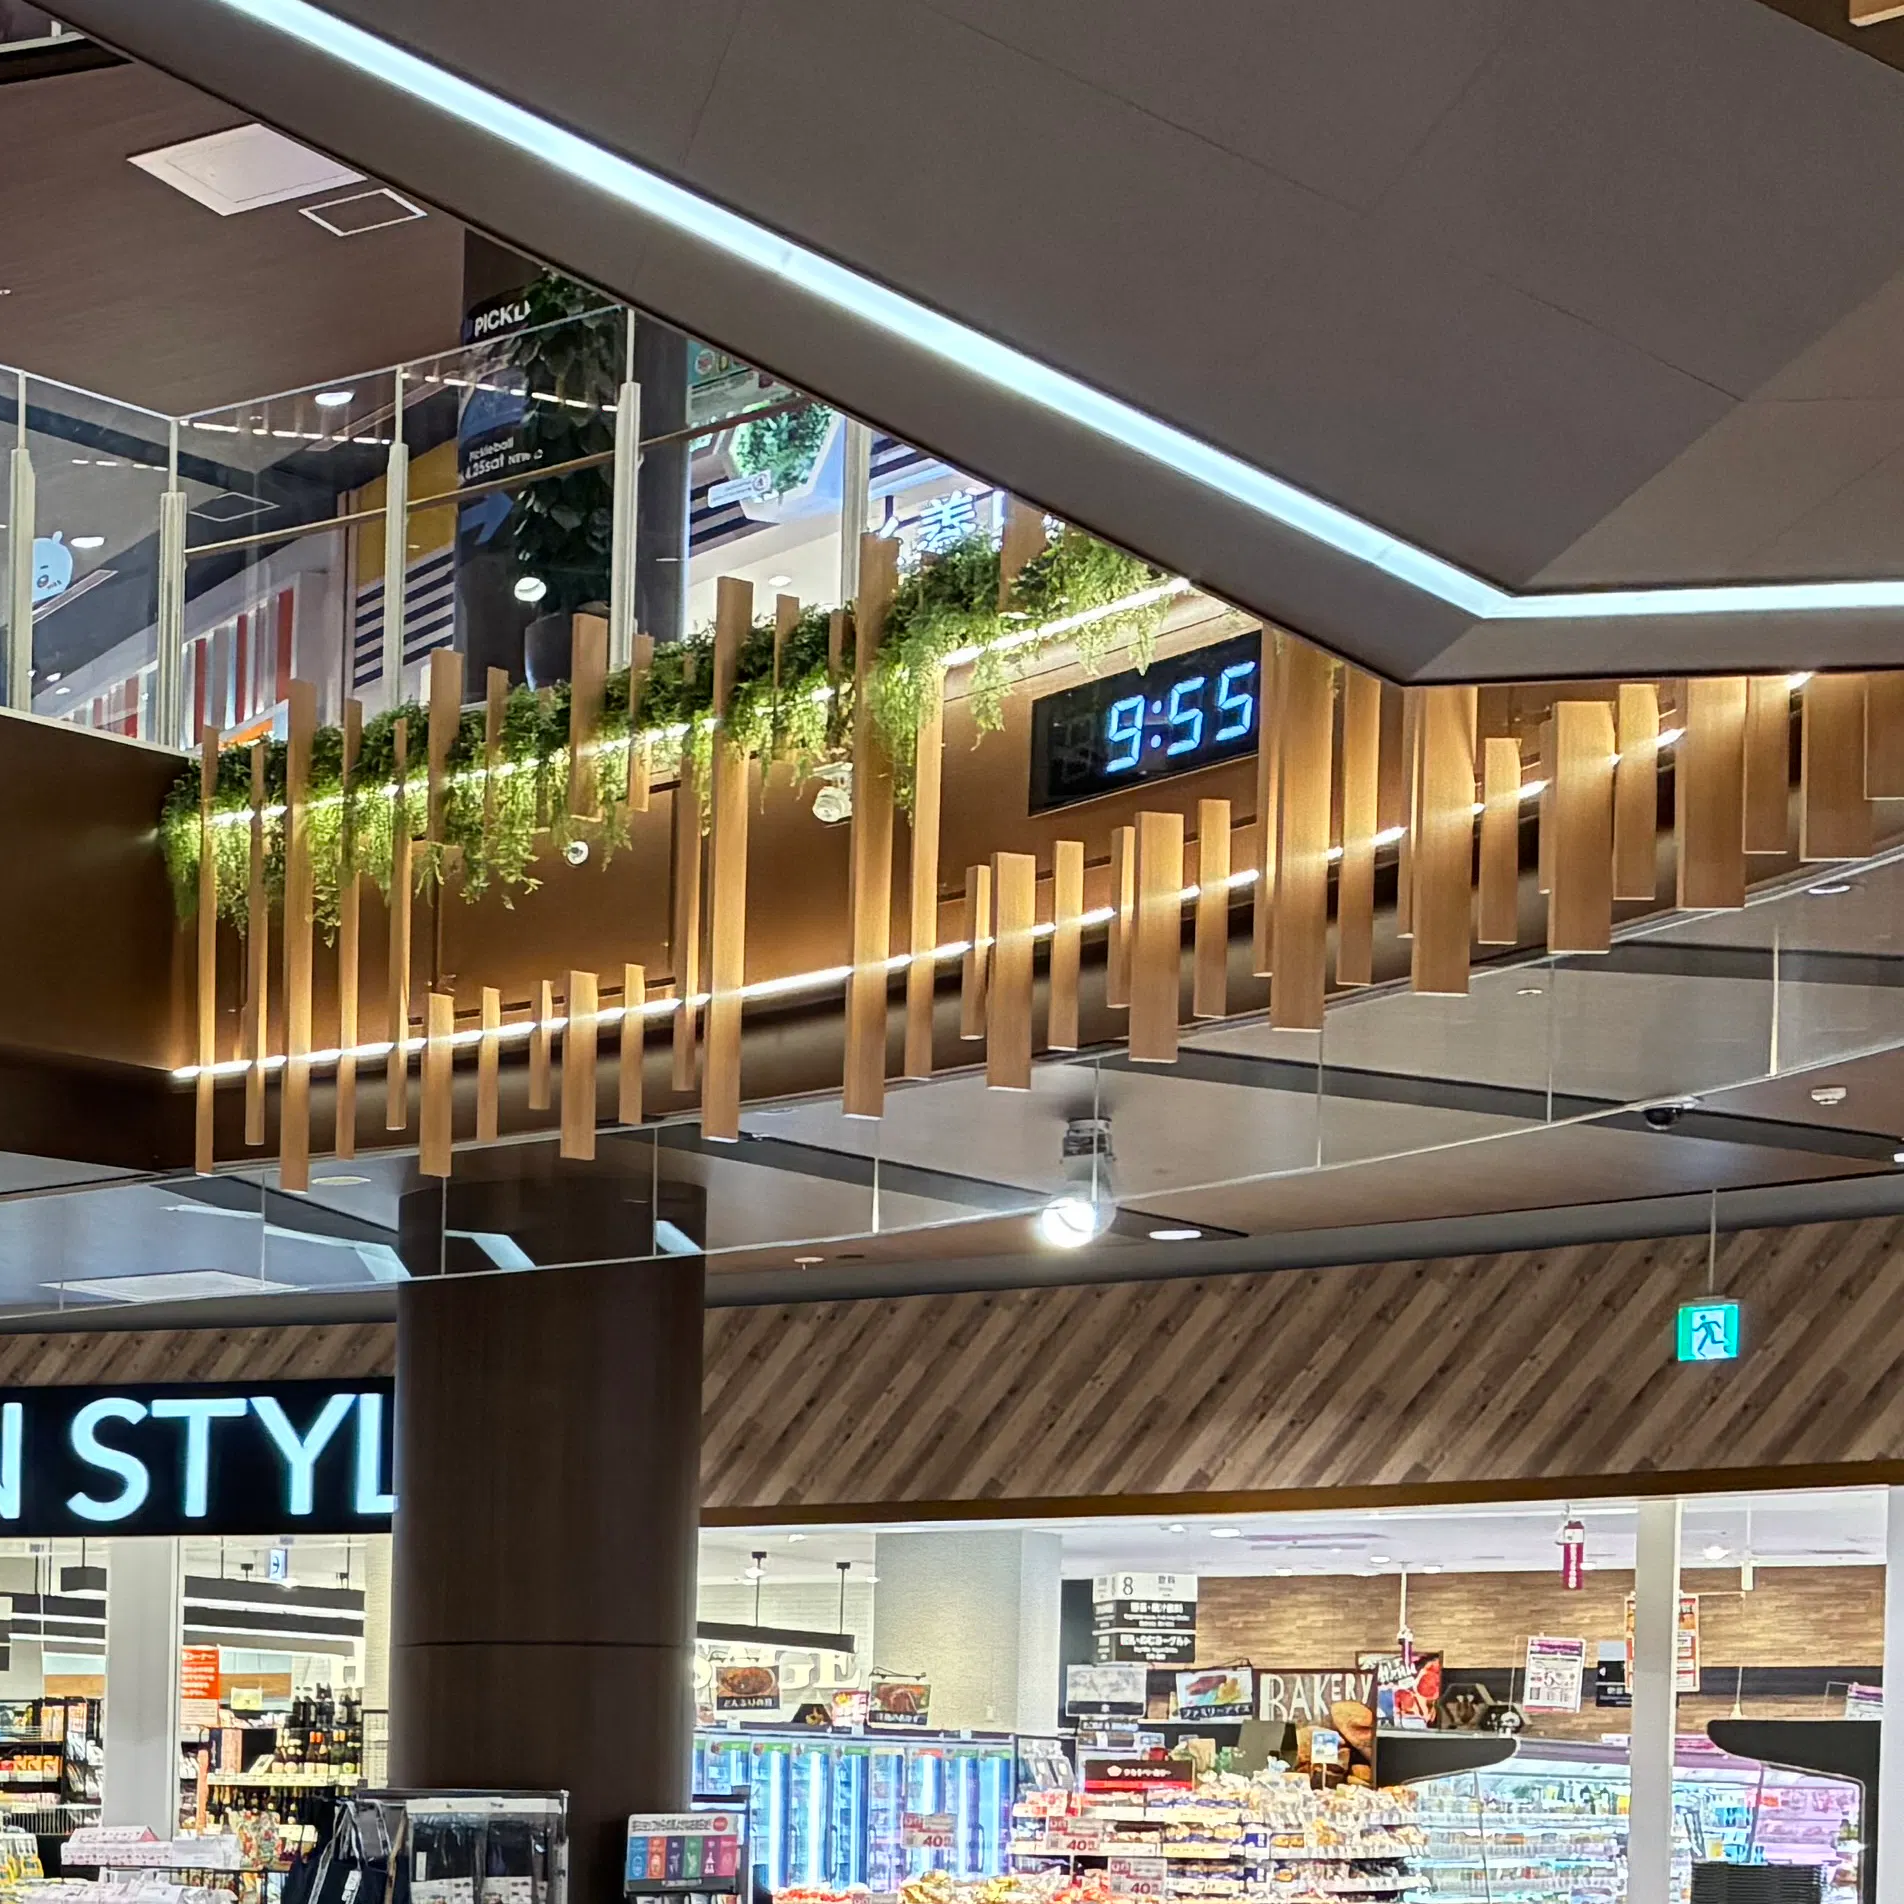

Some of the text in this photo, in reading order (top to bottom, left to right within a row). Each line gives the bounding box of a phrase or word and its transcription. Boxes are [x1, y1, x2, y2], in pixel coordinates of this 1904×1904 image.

[1104, 661, 1257, 775] 9:55
[66, 1393, 398, 1520] STYL
[1122, 1576, 1133, 1595] 8
[1259, 1673, 1374, 1722] BAKERY
